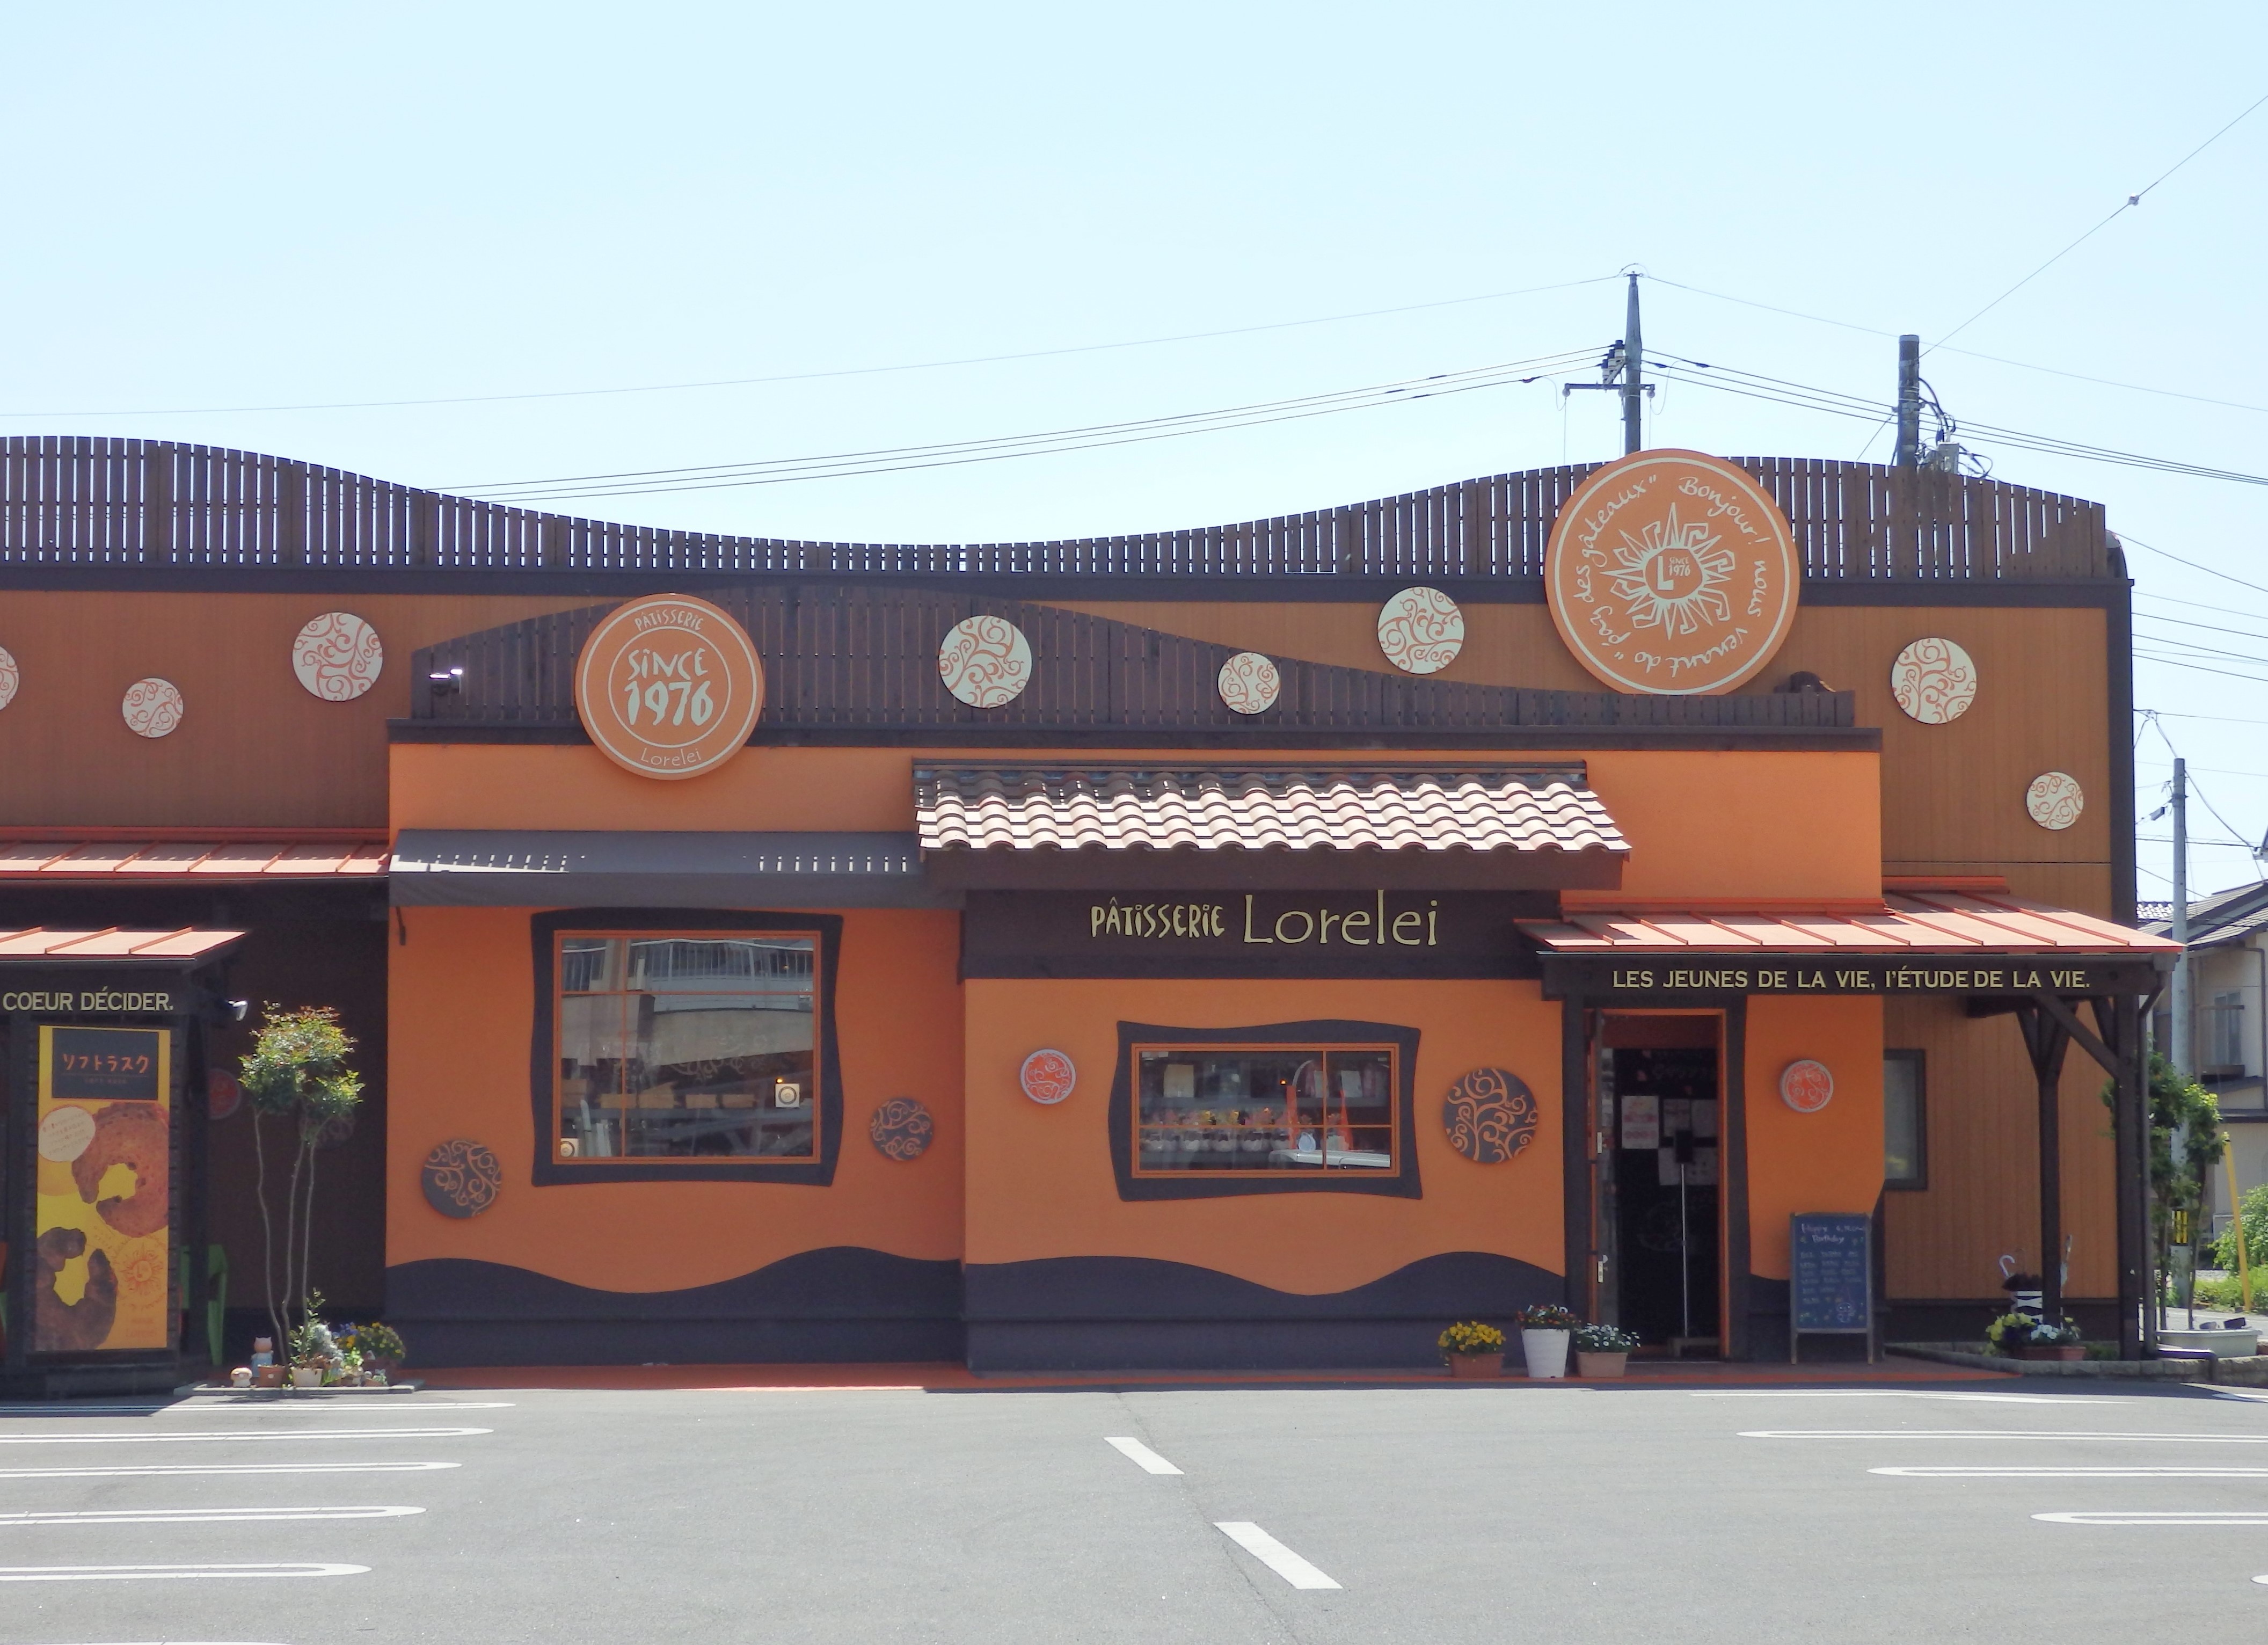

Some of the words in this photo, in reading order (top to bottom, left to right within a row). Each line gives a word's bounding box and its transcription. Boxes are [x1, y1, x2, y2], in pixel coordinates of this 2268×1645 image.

[1573, 565, 1594, 603] des
[1657, 556, 1674, 591] L
[1668, 565, 1690, 576] 1976
[1748, 560, 1767, 617] nous
[1666, 627, 1748, 678] venant
[624, 680, 713, 726] 1976
[641, 748, 701, 767] Lorelei
[1243, 889, 1438, 946] Lorelei
[2, 992, 74, 1011] COEUR
[81, 986, 174, 1011] DÉCIDER.
[1613, 970, 1653, 988] LES
[1663, 970, 1748, 988] JEUNES
[1757, 970, 1788, 988] DE
[1797, 970, 1826, 988] LA
[1835, 970, 1876, 991] VIE,
[1973, 970, 2003, 988] DE
[2013, 970, 2041, 988] LA
[2050, 970, 2090, 988] VIE.
